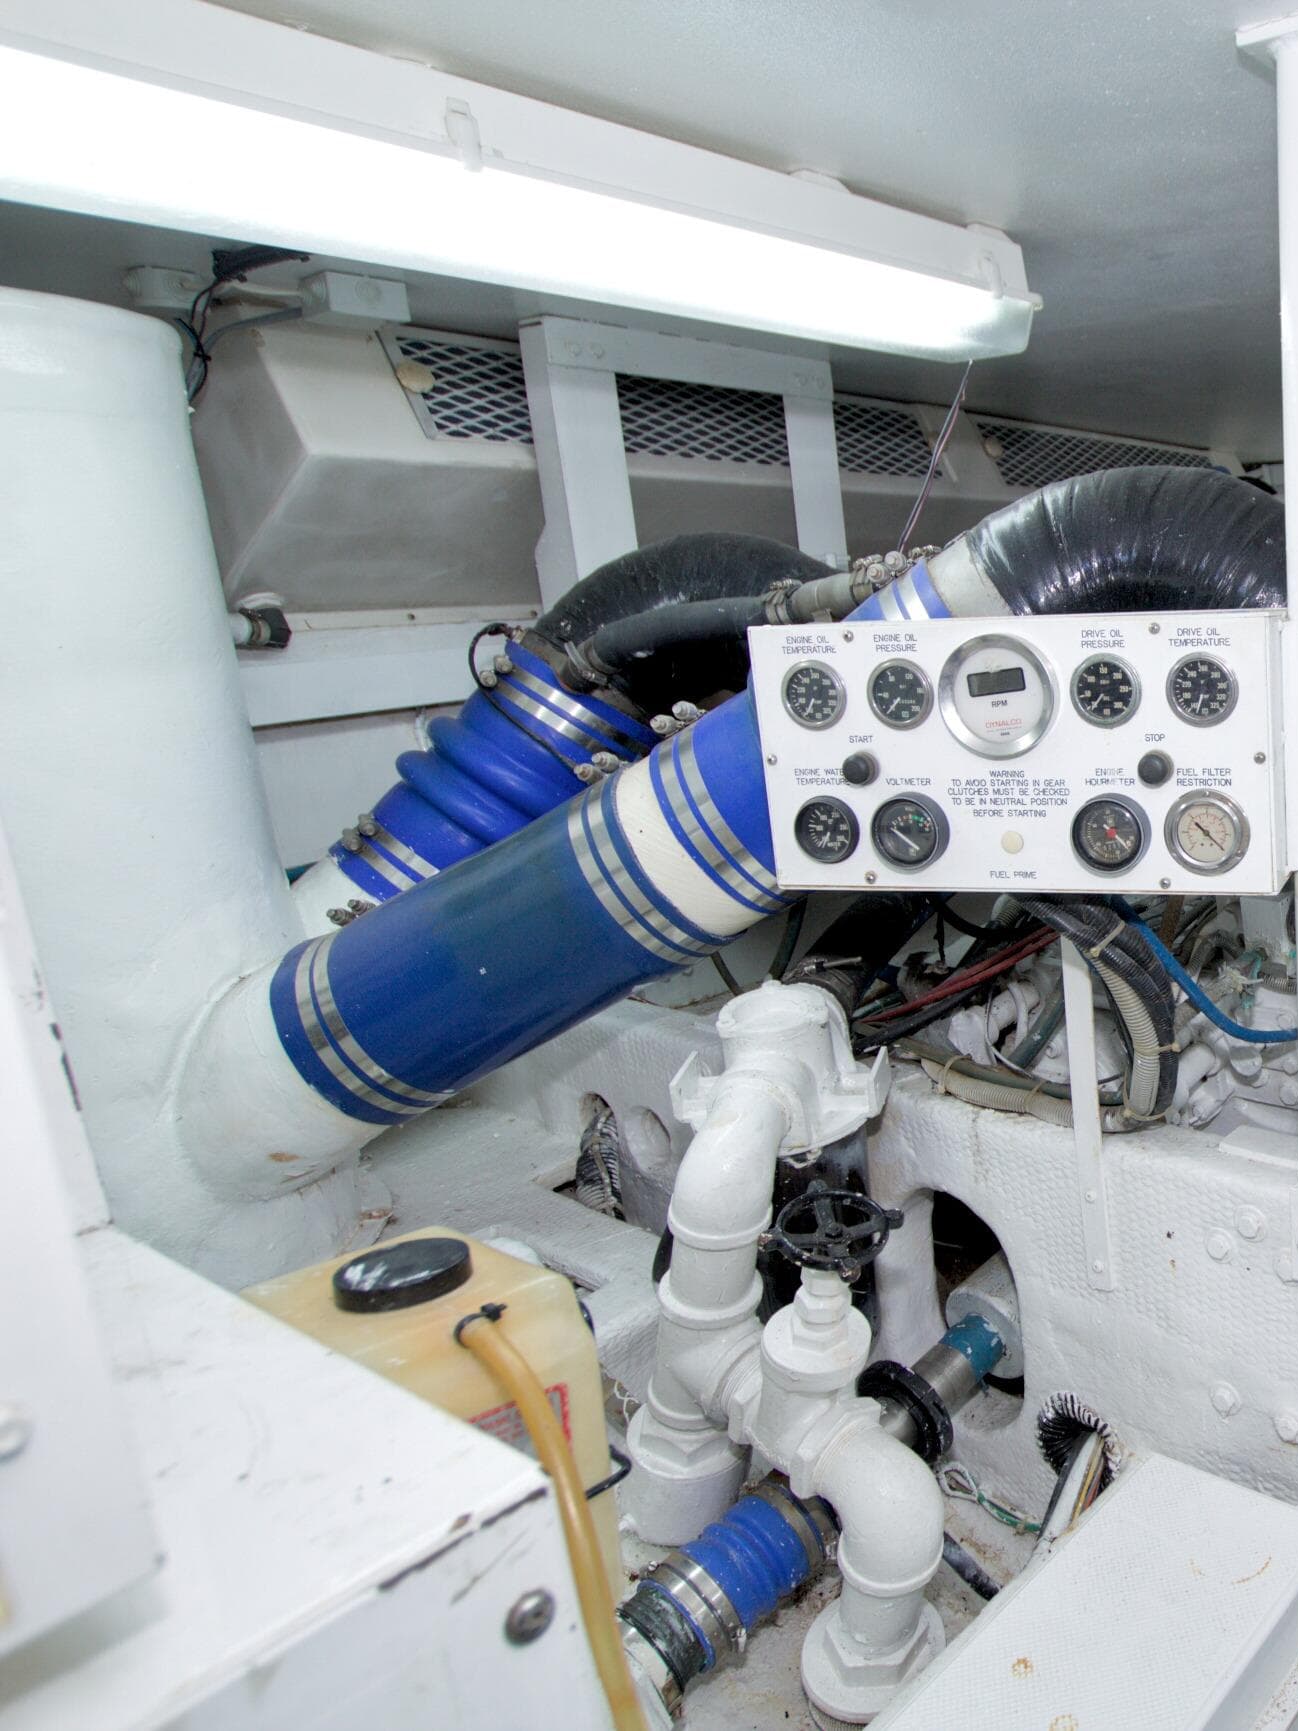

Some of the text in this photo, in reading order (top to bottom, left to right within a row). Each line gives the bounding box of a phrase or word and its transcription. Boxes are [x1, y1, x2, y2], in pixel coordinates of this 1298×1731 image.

[1081, 629, 1124, 638] DRIVE OIL
[1176, 628, 1220, 637] DRIVE OIL
[786, 635, 829, 644] ENGINE OIL
[874, 633, 917, 643] ENGINE OIL
[1081, 639, 1125, 648] PRESSURE
[1168, 638, 1231, 647] TEMPERATURE
[782, 645, 836, 654] TEMPERATURE
[876, 644, 917, 652] PRESSURE
[1145, 734, 1165, 742] STOP
[824, 768, 844, 776] WATE
[989, 770, 1024, 778] WARNING
[1095, 768, 1124, 776] ENGINE
[1177, 768, 1231, 776] FUEL FILTER
[1085, 778, 1135, 786] HOURMETER
[1177, 778, 1232, 786] RESTRICTION
[948, 788, 1070, 796] CLUTCHES MUST BE CHECKED
[1014, 871, 1037, 879] PRIME
